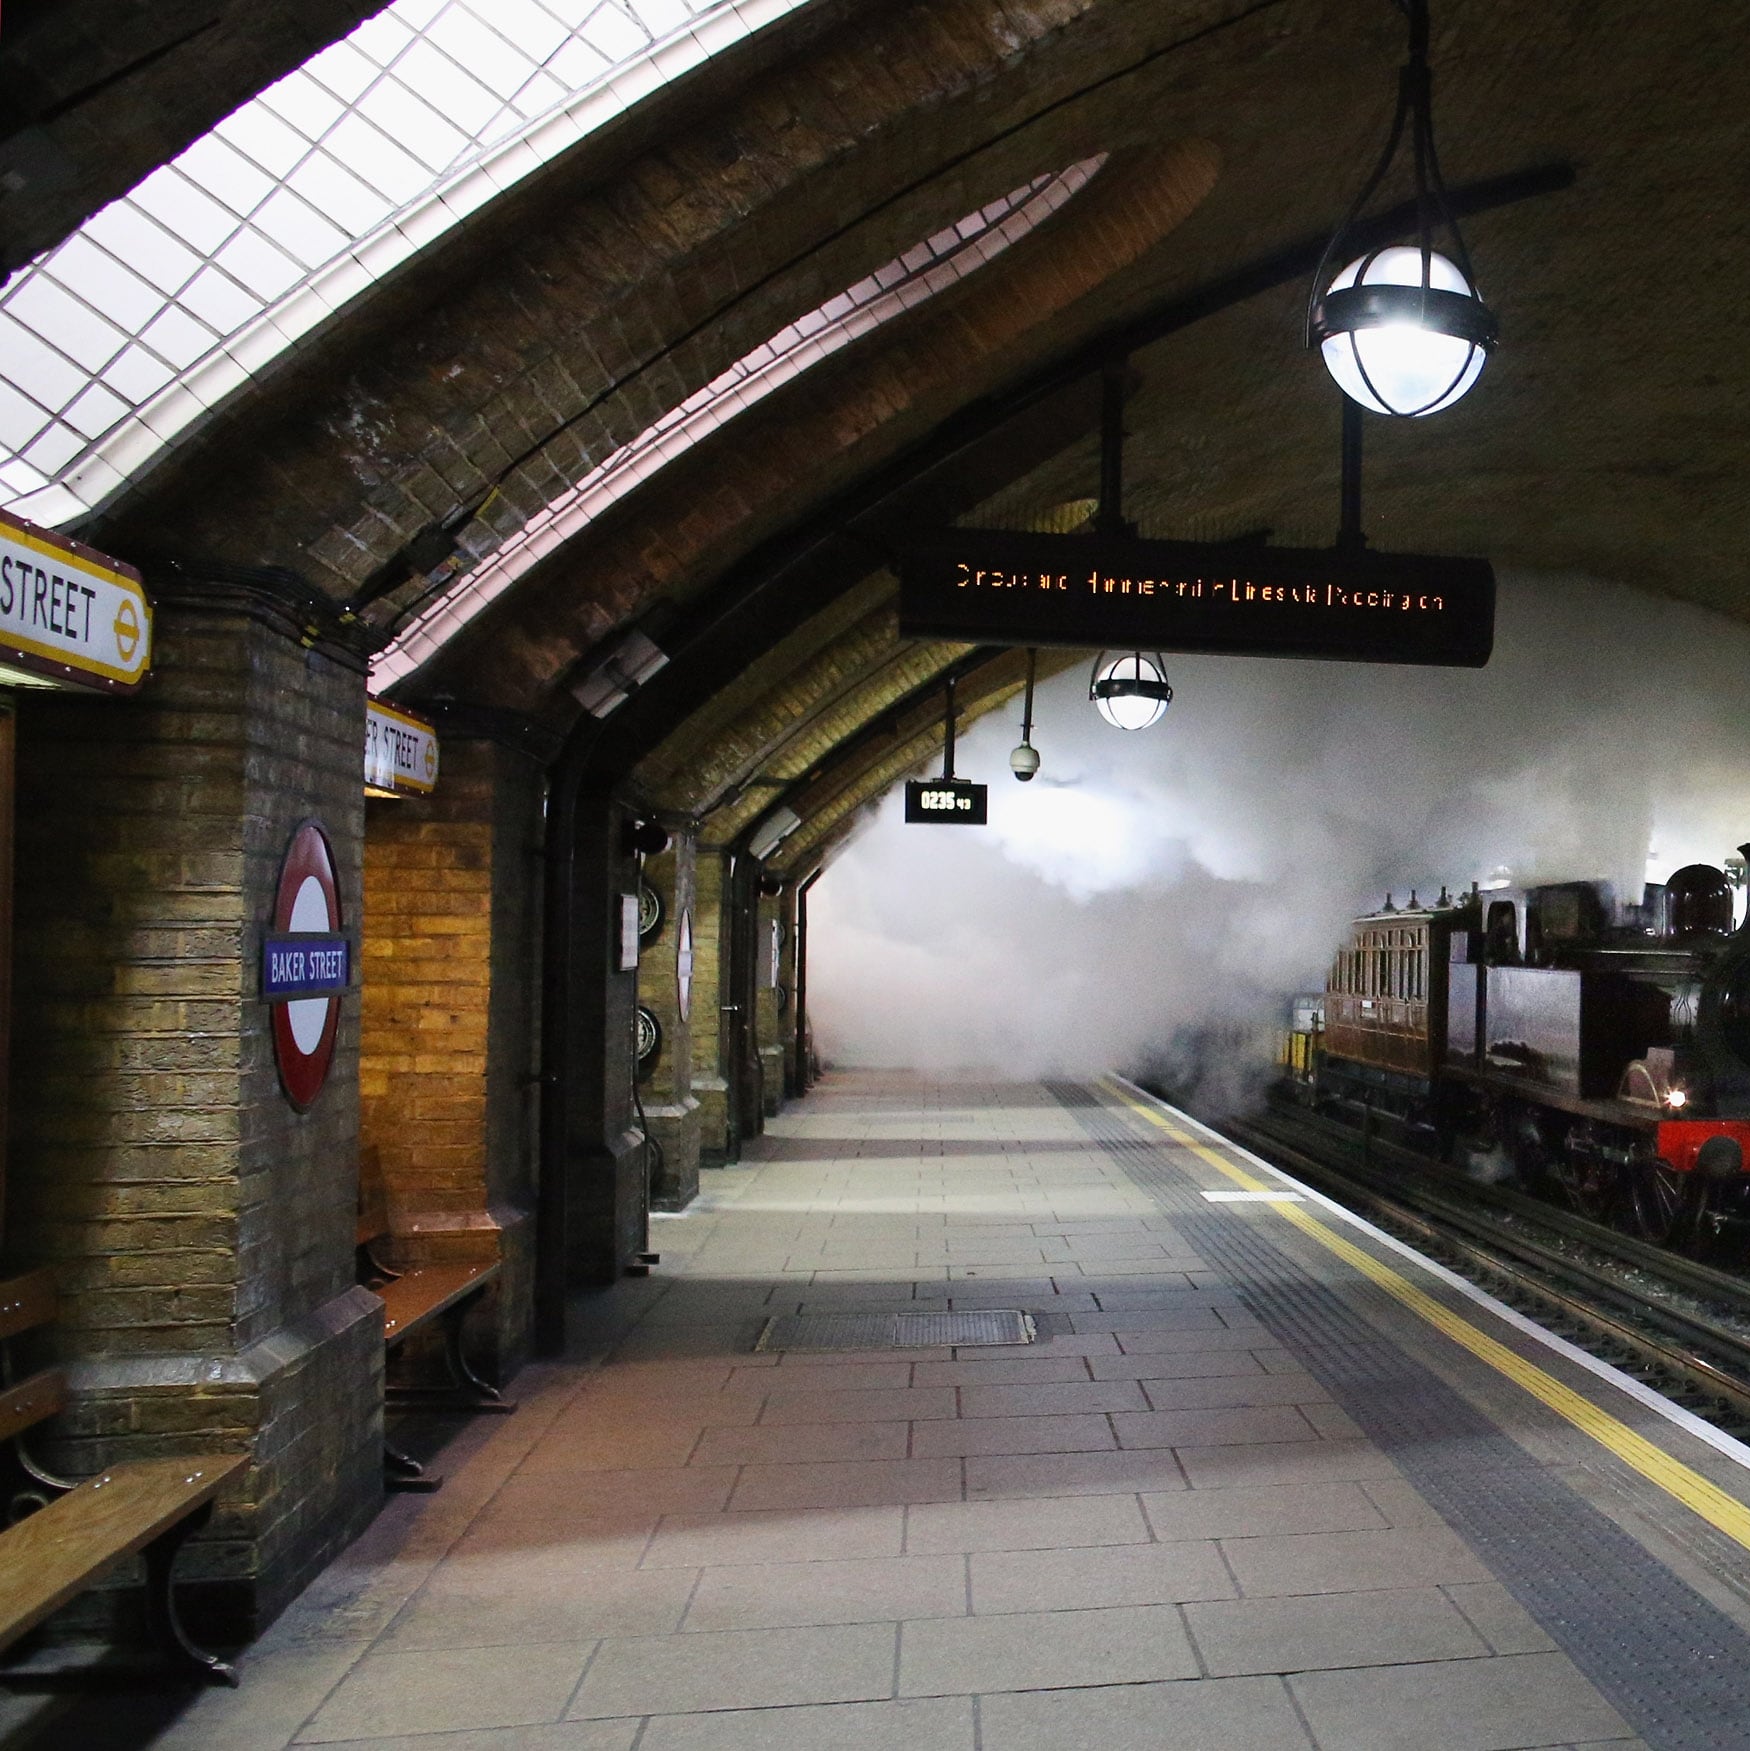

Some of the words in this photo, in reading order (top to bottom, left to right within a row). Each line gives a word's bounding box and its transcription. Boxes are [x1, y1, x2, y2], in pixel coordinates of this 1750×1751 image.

[0, 555, 96, 642] STREET
[384, 725, 419, 771] STREET
[921, 791, 955, 810] 0235
[271, 951, 305, 983] BAKER
[309, 950, 343, 980] STREET
